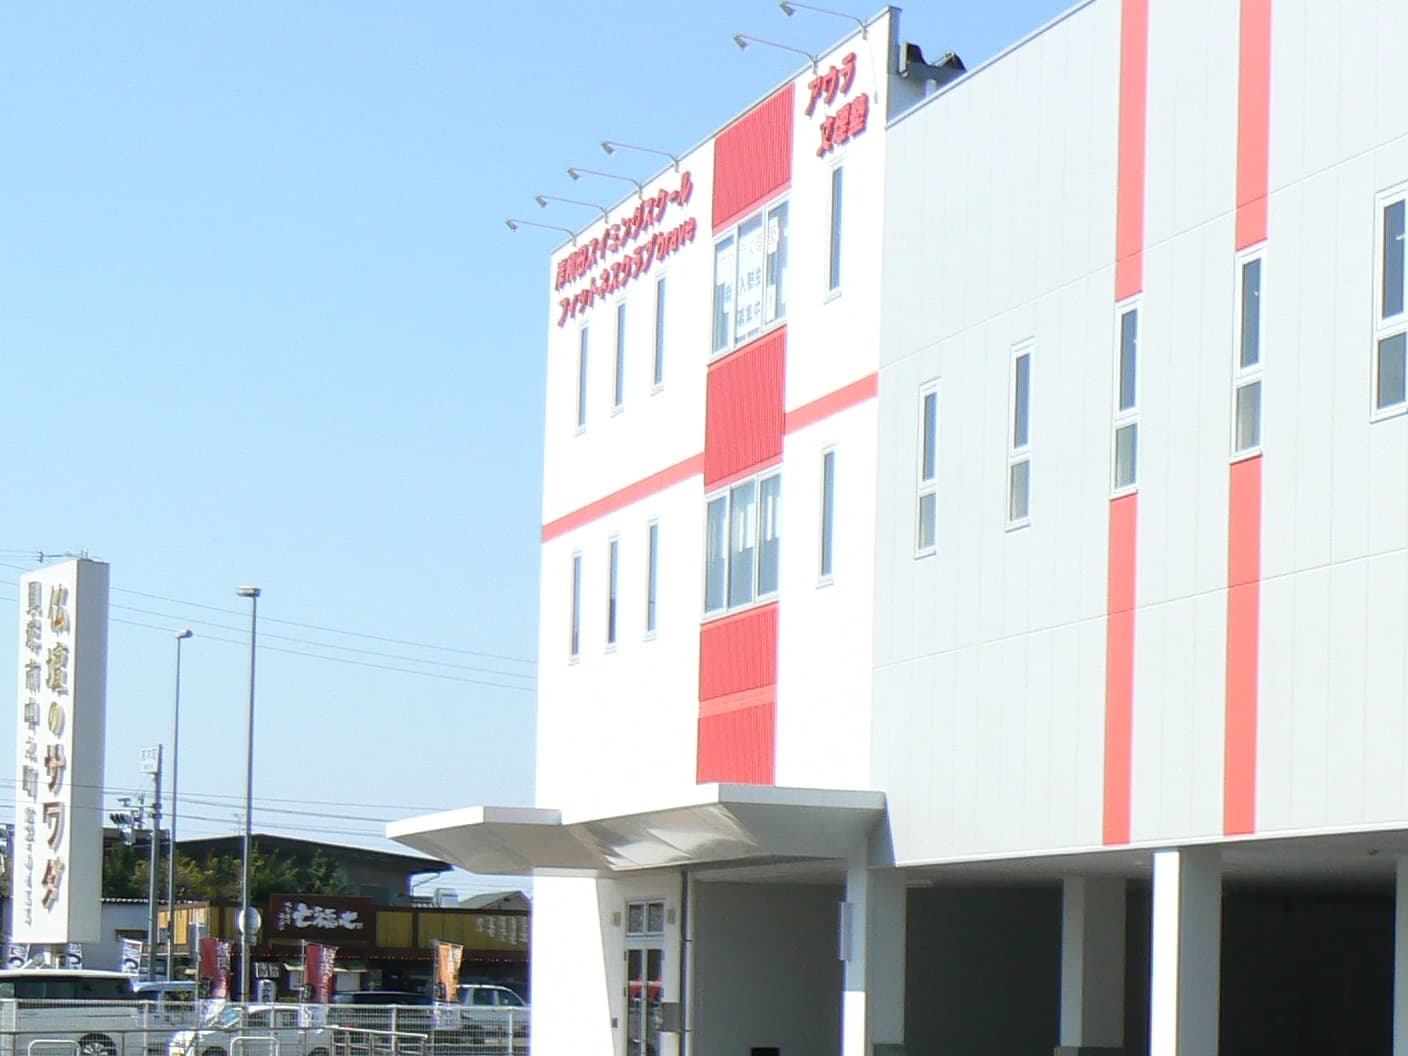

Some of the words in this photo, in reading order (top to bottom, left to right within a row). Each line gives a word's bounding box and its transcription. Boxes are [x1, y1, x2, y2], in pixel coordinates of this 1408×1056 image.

[805, 52, 857, 119] アウラ
[41, 583, 71, 913] 仏壇のサワダ
